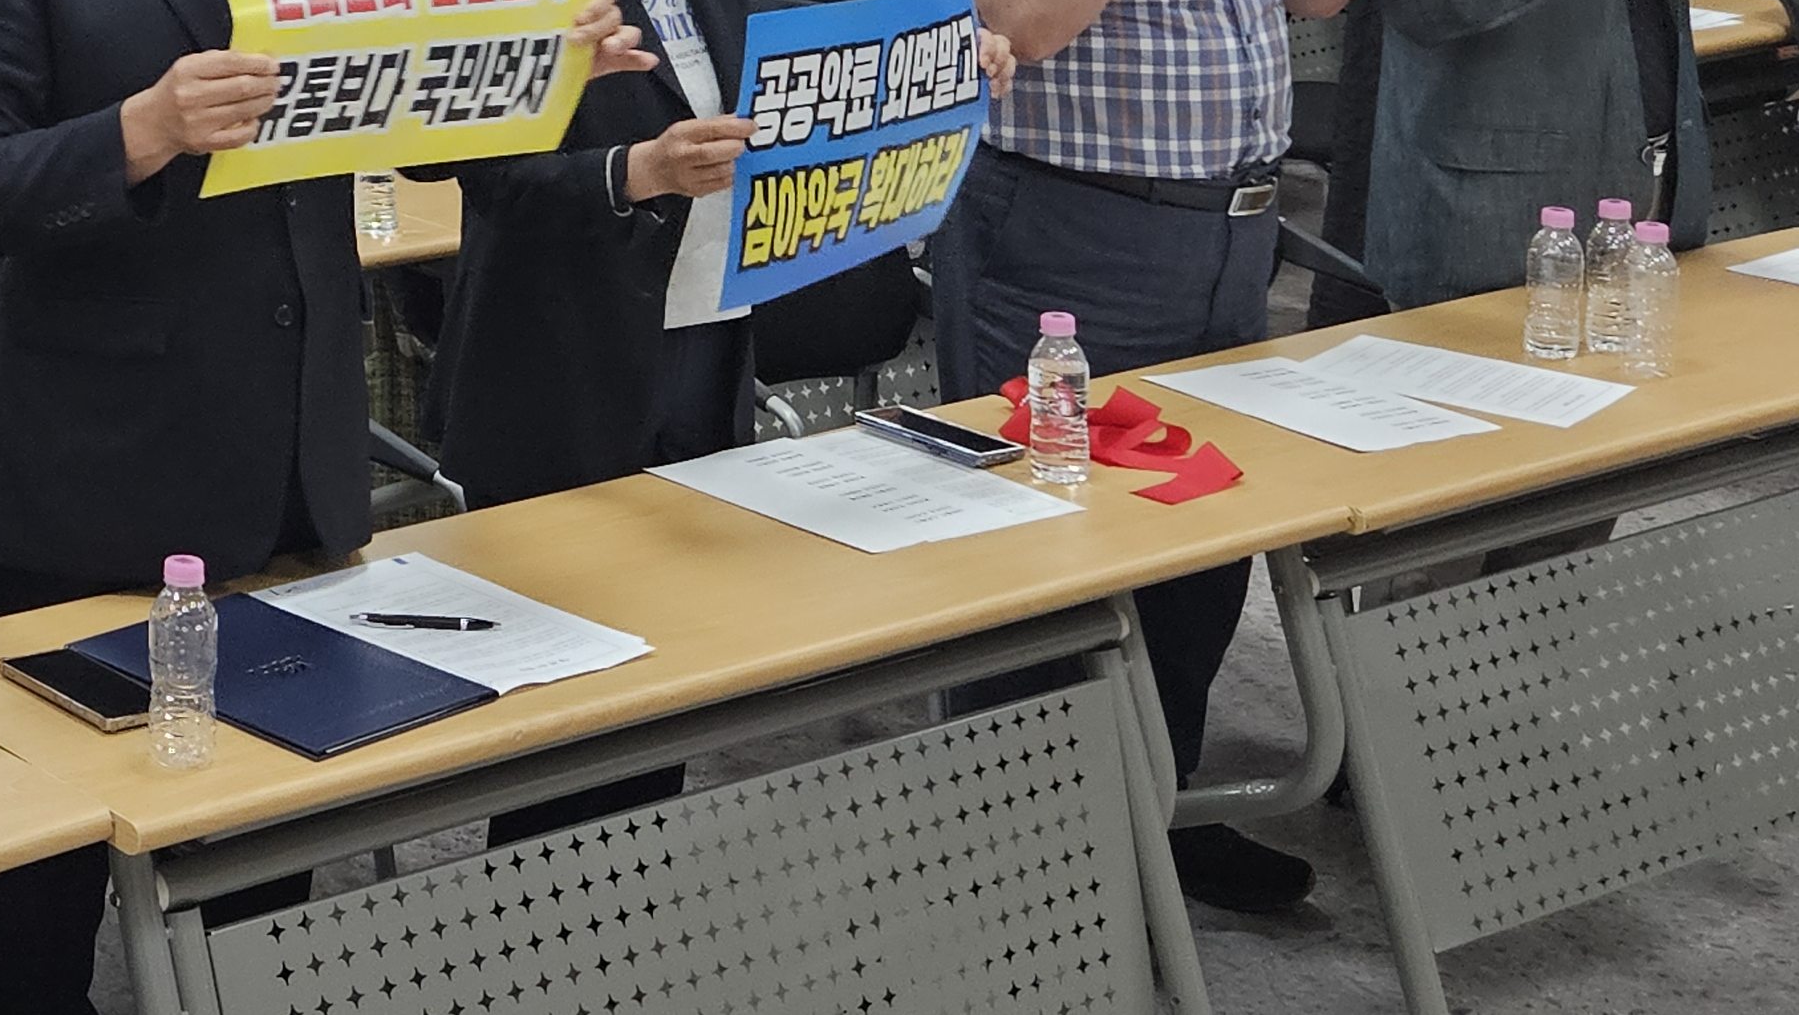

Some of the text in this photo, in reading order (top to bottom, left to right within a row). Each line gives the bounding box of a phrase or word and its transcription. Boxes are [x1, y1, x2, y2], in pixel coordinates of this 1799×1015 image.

[252, 32, 563, 145] 유통보다 국민먼저
[880, 15, 980, 125] 외면말고
[741, 128, 971, 269] 심야약국 확대하라
